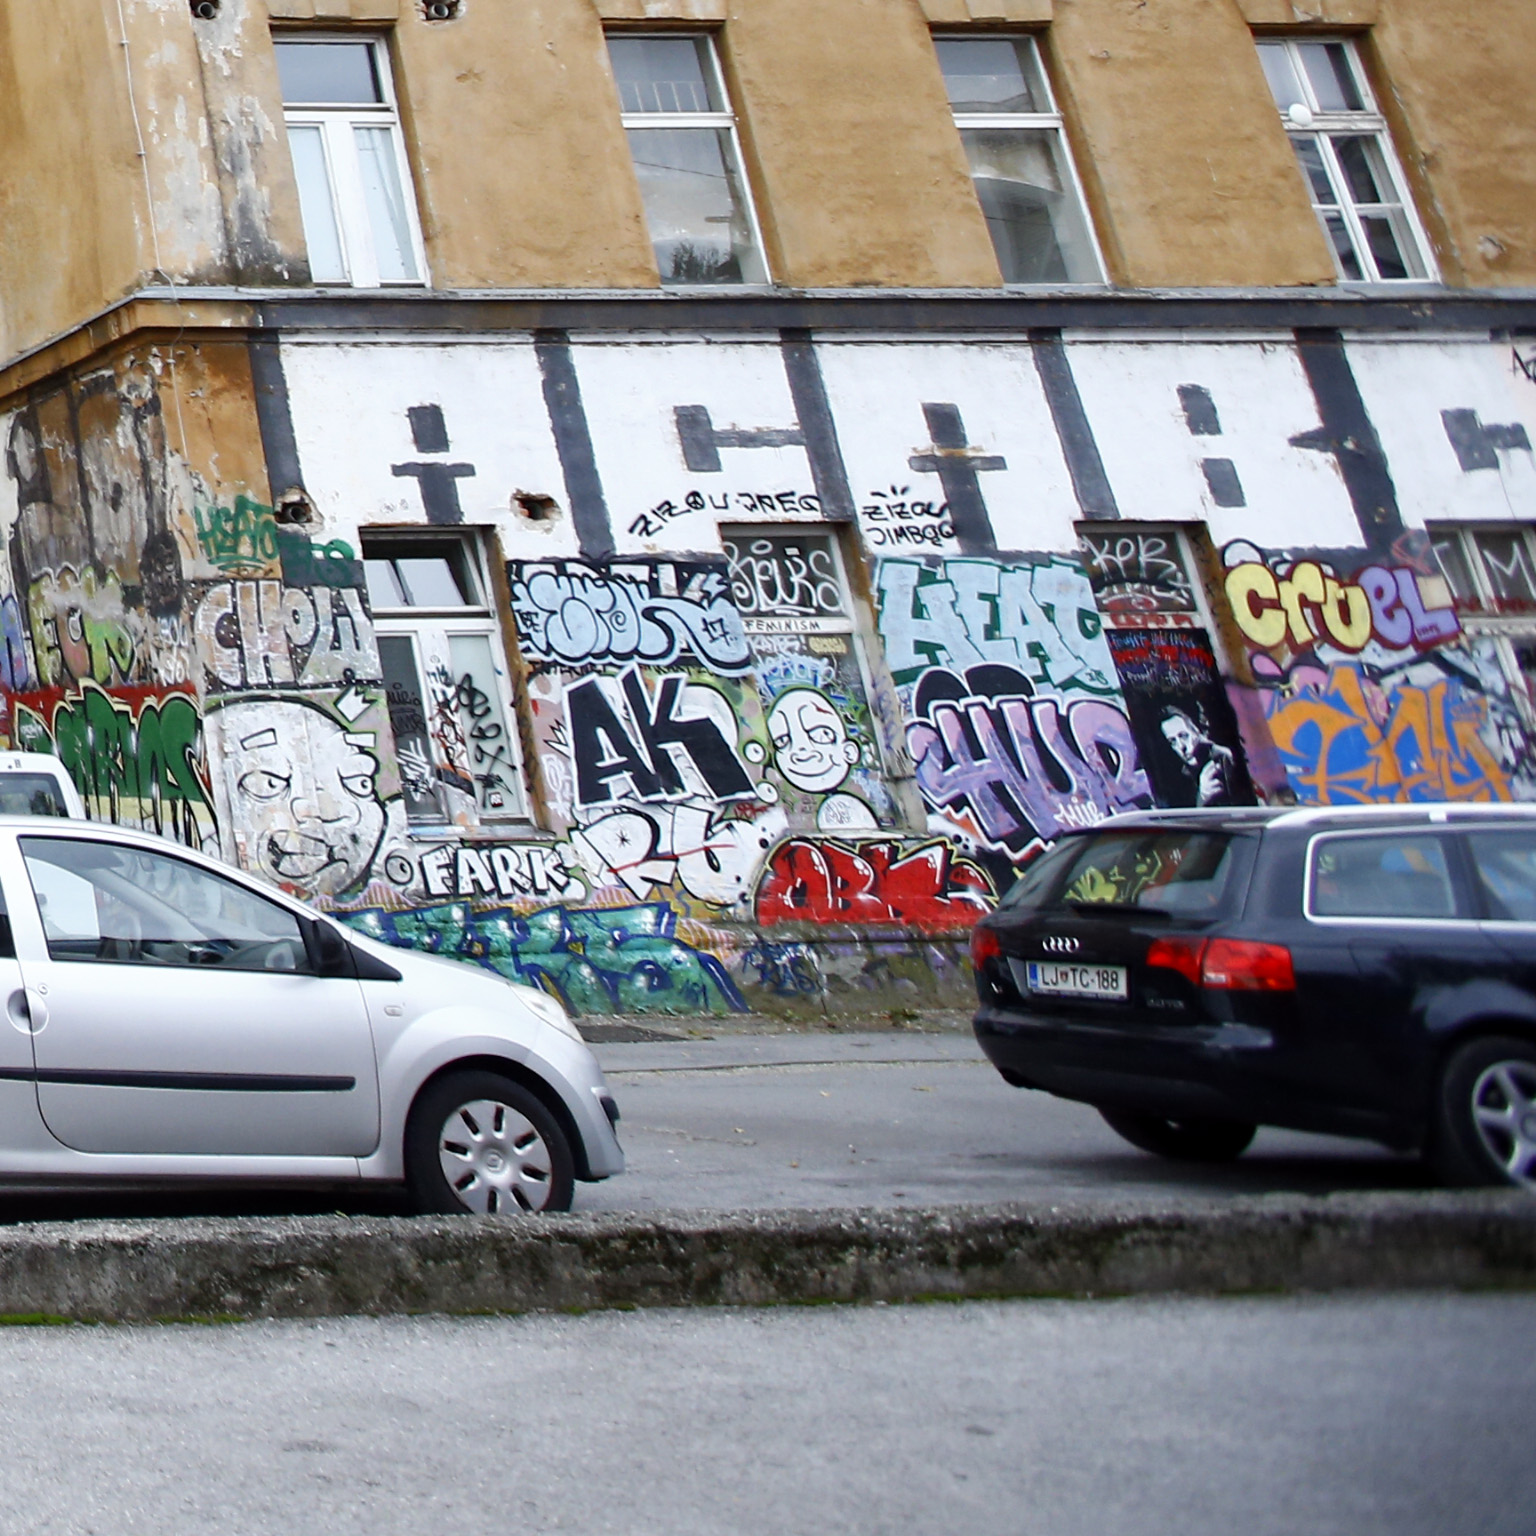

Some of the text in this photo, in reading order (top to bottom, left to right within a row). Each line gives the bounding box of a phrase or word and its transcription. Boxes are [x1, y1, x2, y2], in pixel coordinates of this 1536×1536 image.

[743, 619, 822, 631] FEMINISM
[1041, 966, 1119, 991] LJ TC-188
